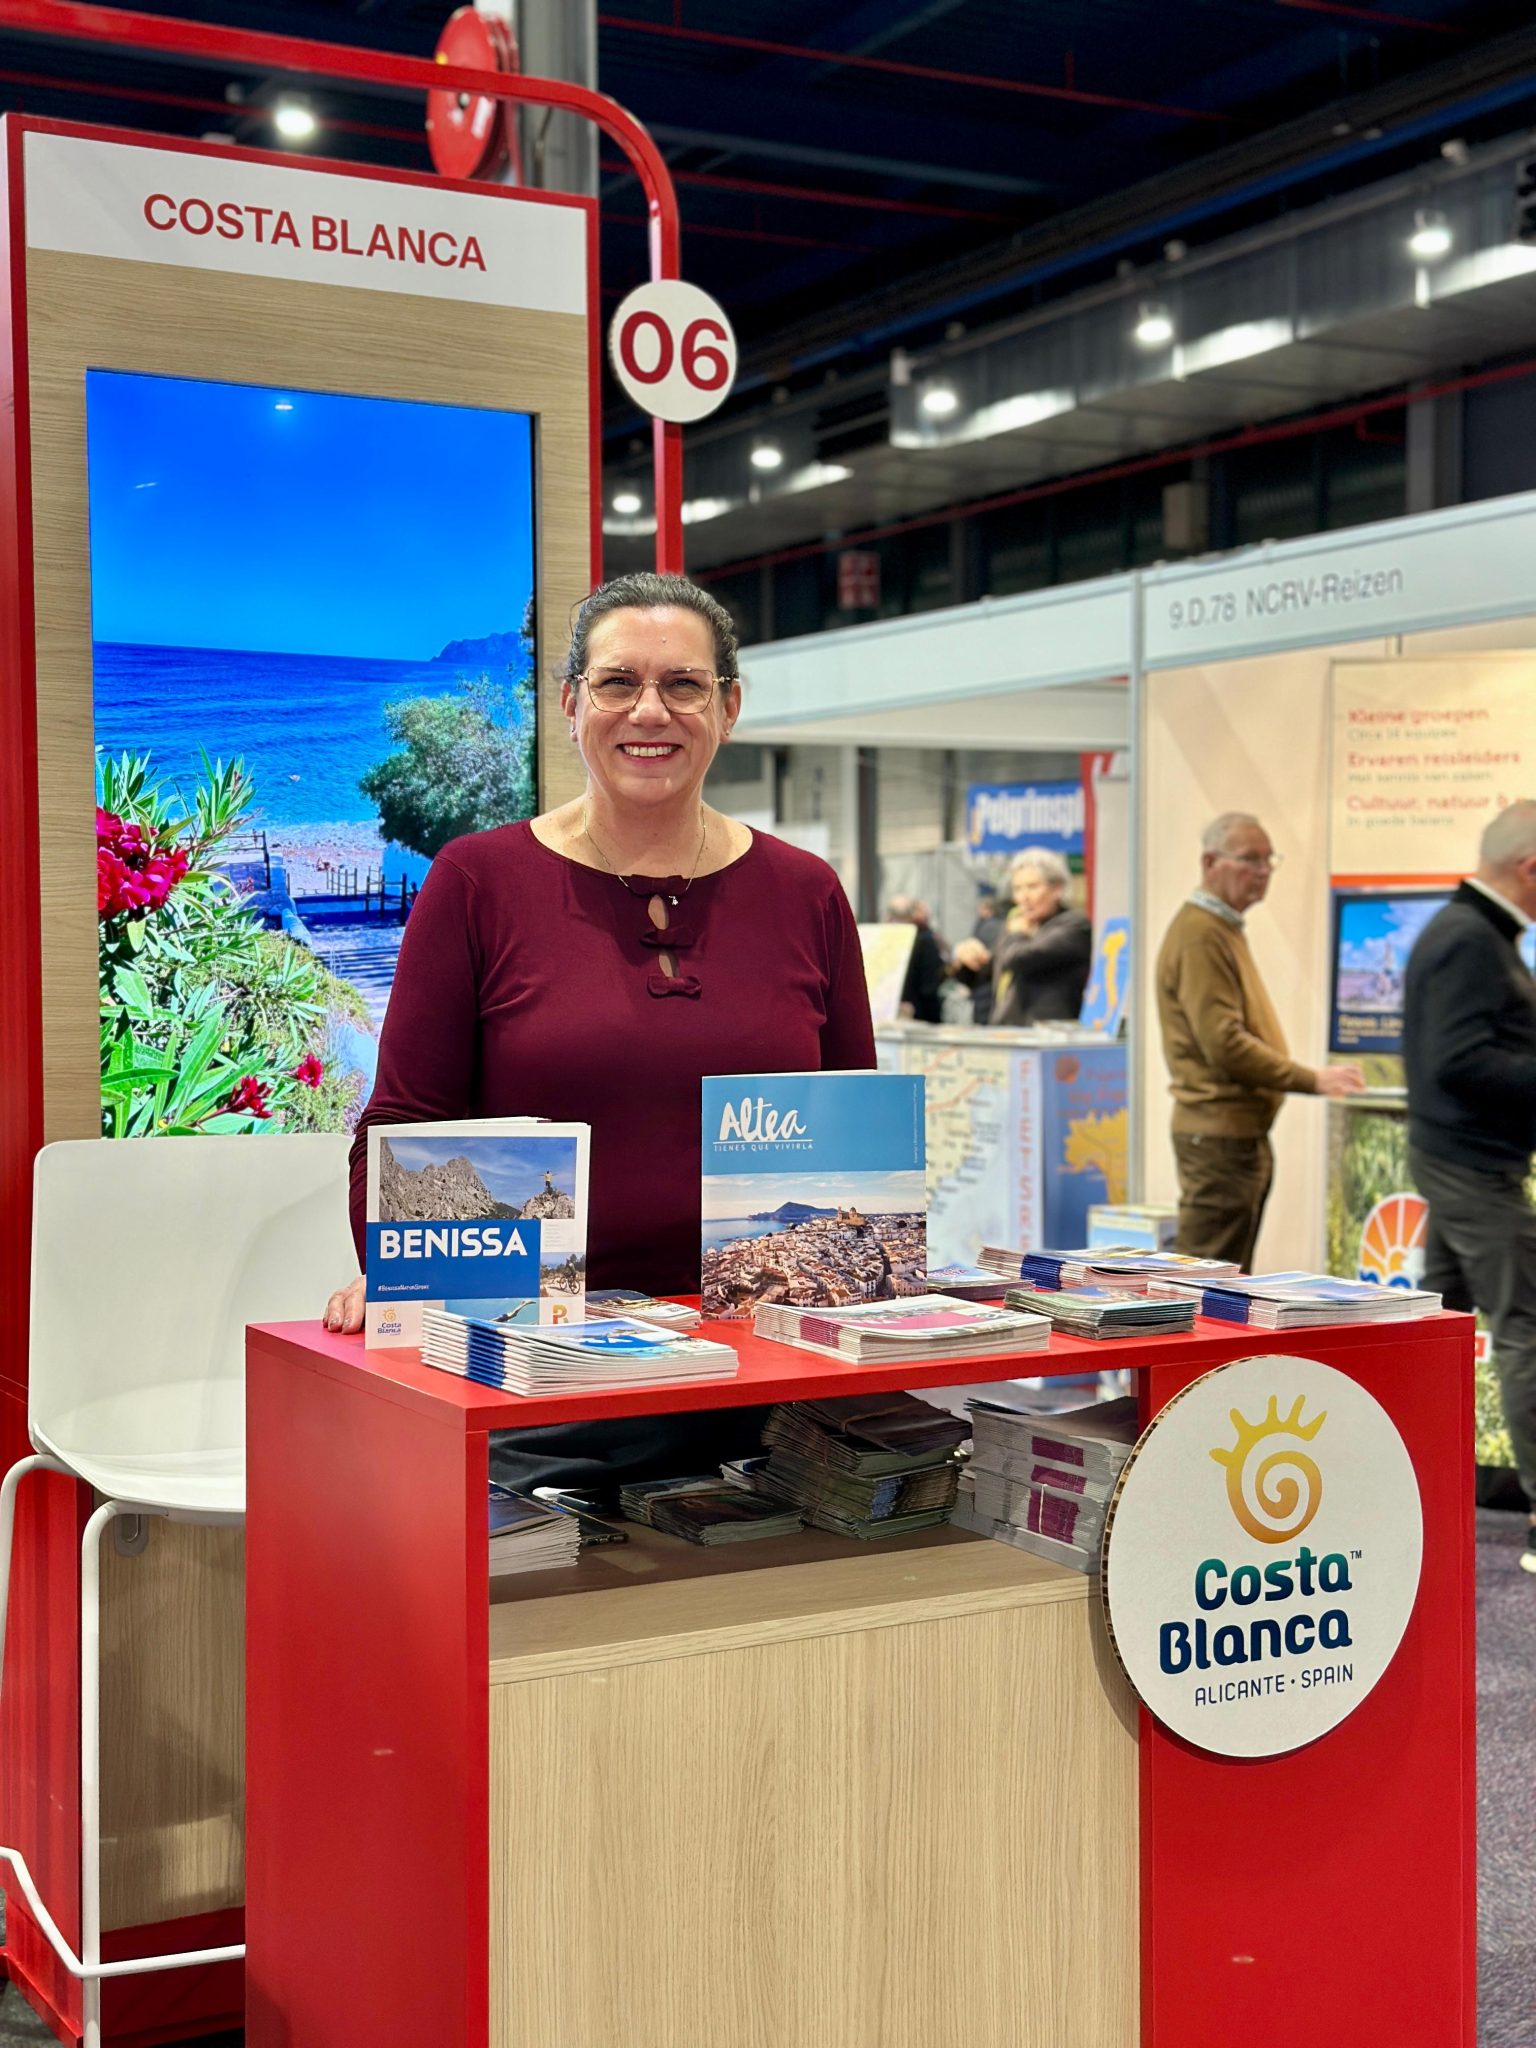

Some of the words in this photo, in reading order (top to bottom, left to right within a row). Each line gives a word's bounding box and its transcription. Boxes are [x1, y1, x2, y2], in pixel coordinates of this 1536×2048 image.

[143, 193, 301, 248] COSTA
[312, 216, 487, 272] BLANCA
[620, 310, 730, 391] 06
[1168, 592, 1237, 630] 9.D.78
[1247, 568, 1404, 617] NCRV-Reizen
[1410, 708, 1489, 726] groepen
[1348, 752, 1419, 769] Ervaren
[1424, 749, 1521, 766] reisleiders
[1427, 795, 1490, 811] natuur
[719, 1097, 807, 1141] Altea
[714, 1143, 746, 1152] TIENES
[751, 1143, 770, 1152] QUE
[380, 1227, 528, 1259] BENISSA
[381, 1321, 402, 1329] Costa
[1195, 1546, 1352, 1611] Costa
[1159, 1608, 1353, 1675] Blanca
[1194, 1673, 1286, 1707] ALICANTE
[1300, 1662, 1354, 1690] SPAIN
